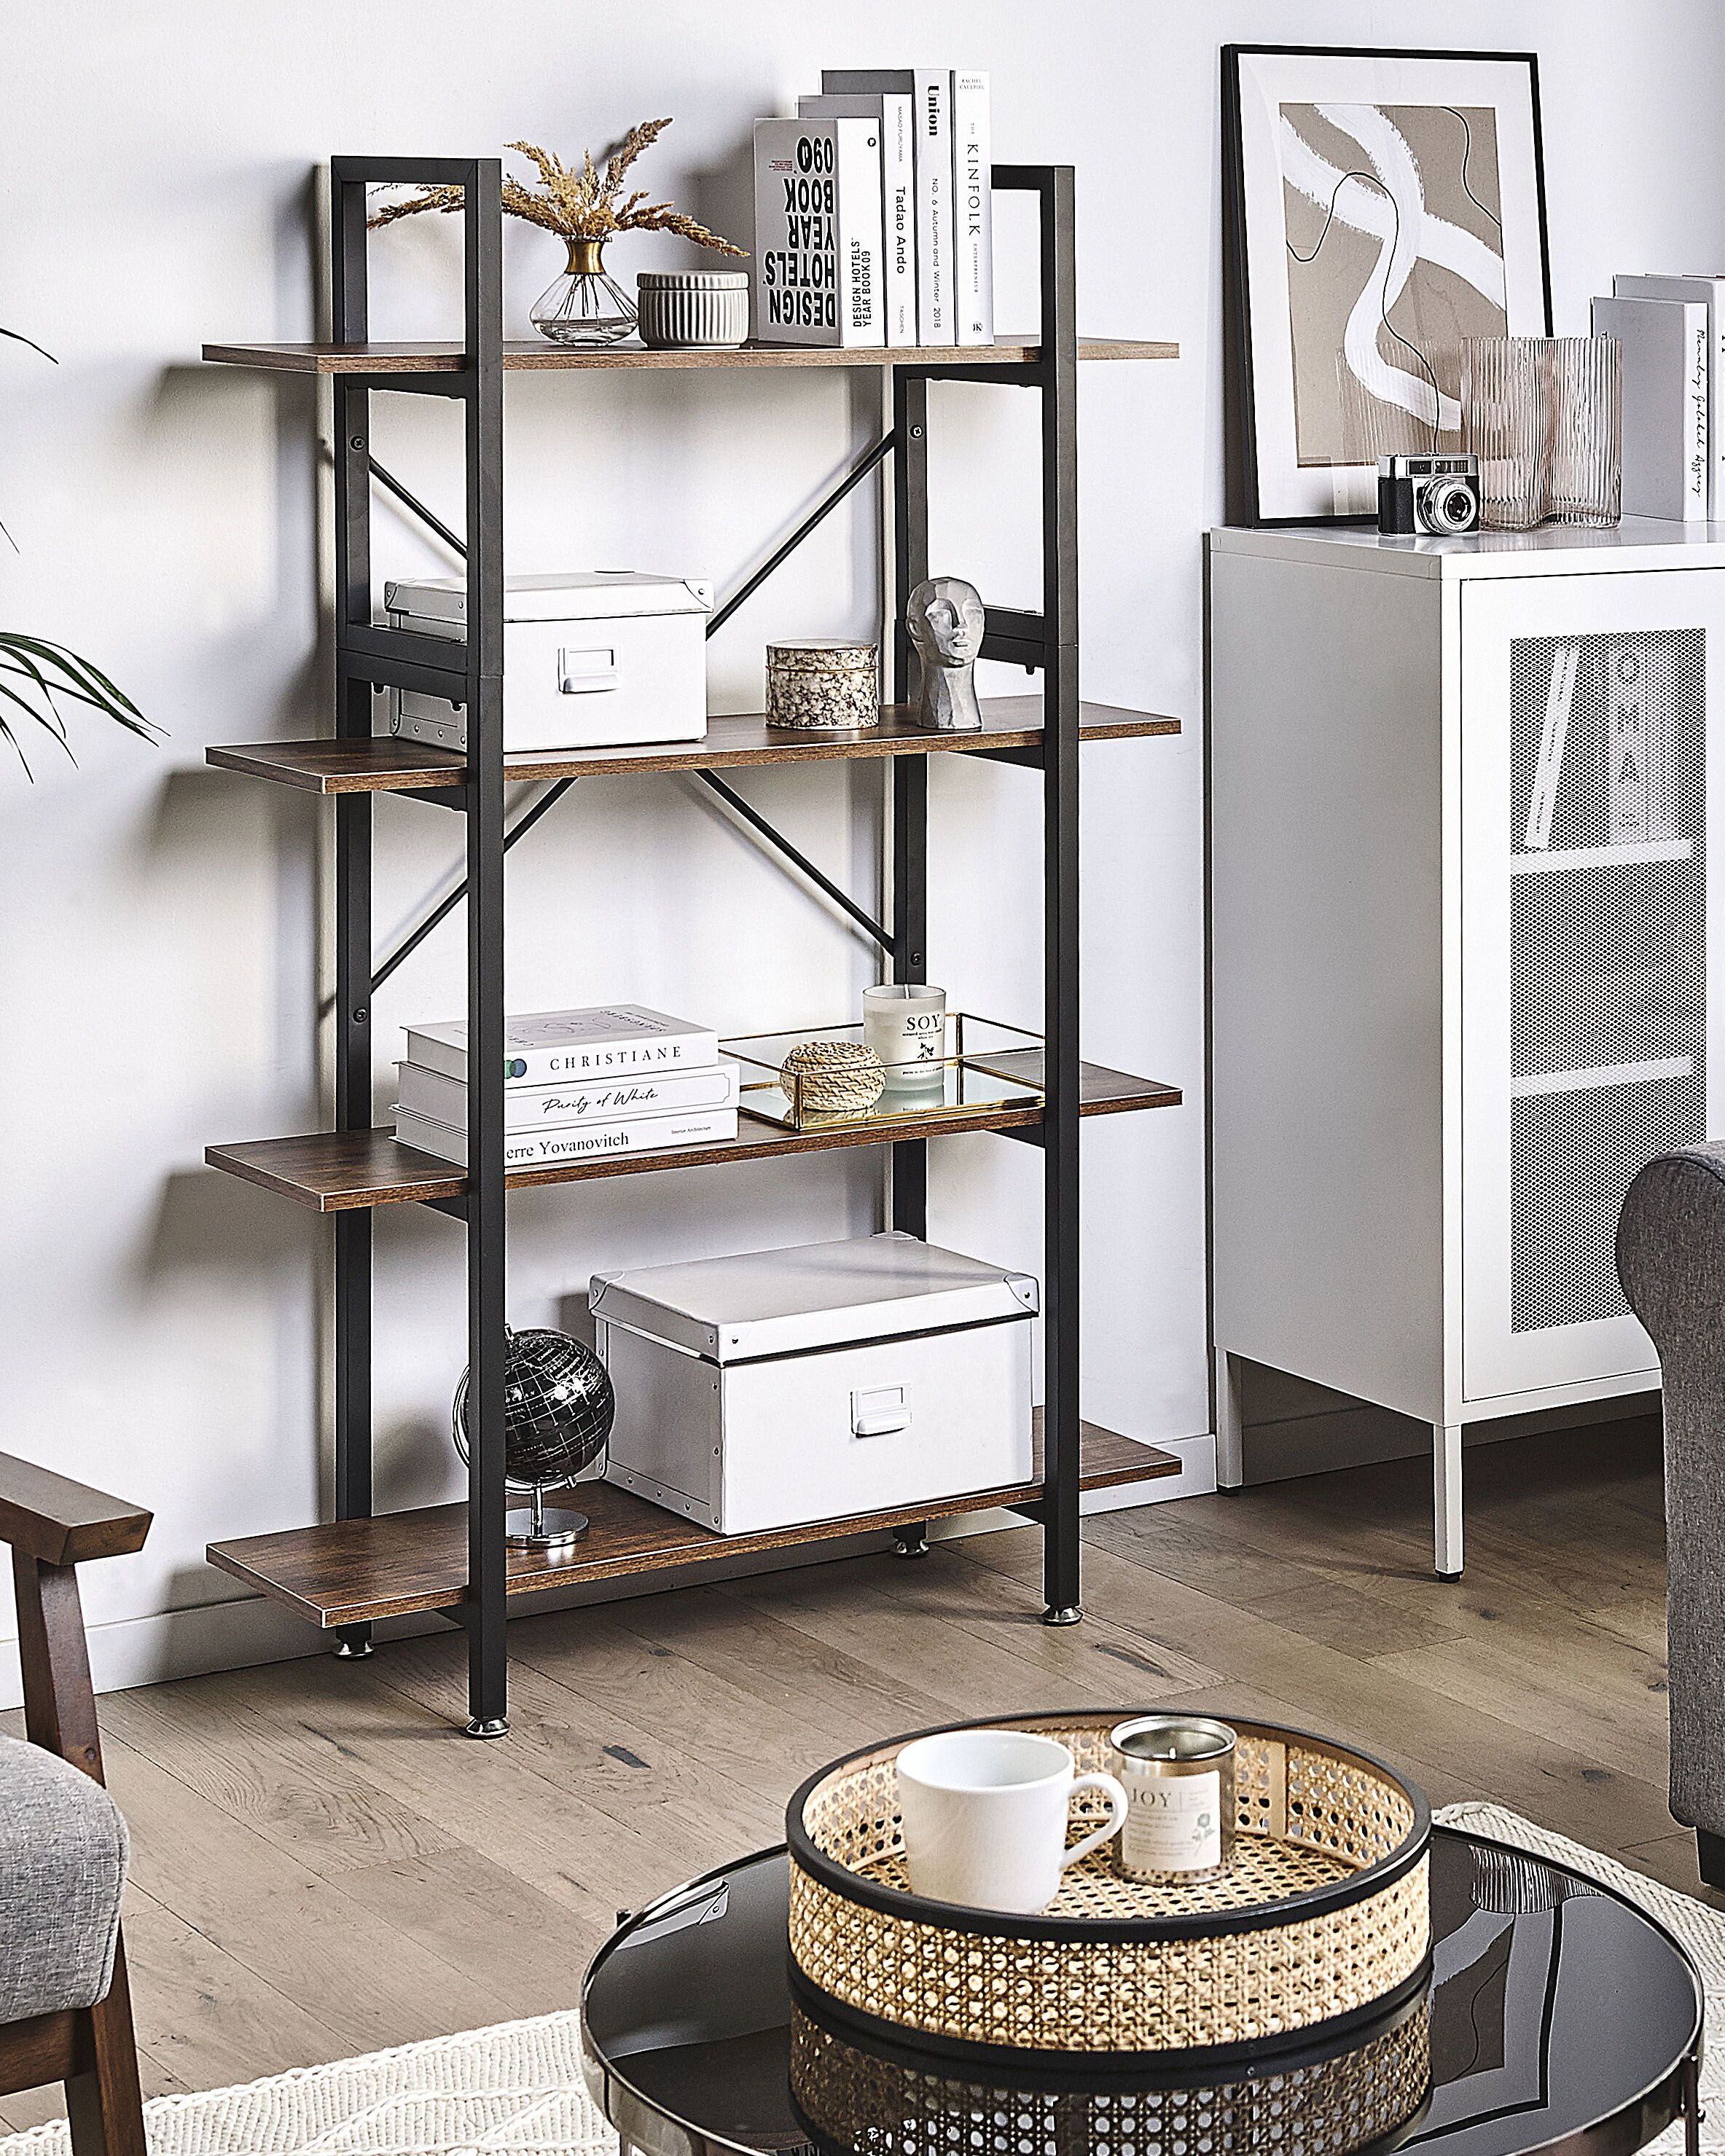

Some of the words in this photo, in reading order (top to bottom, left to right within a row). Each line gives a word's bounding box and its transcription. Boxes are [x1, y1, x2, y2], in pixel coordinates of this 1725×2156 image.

[927, 85, 940, 136] Union
[783, 178, 834, 214] BOOK
[967, 144, 980, 236] KINFOLK
[896, 186, 907, 231] Tadao
[787, 215, 835, 251] YEAR
[764, 251, 835, 289] HOTELS
[850, 240, 861, 283] HOTELS
[896, 235, 907, 274] Ando
[769, 289, 836, 327] DESIGN
[852, 287, 862, 327] DESIGN
[862, 299, 872, 327] YEAR
[933, 307, 942, 328] 2018
[907, 1014, 940, 1030] SOY
[549, 1046, 681, 1071] CHRISTIANE
[542, 1095, 592, 1114] Purity
[596, 1093, 612, 1108] of
[614, 1088, 658, 1106] White
[506, 1145, 534, 1159] erre
[539, 1132, 629, 1156] Yovanovitch
[1130, 1788, 1172, 1808] JOY
